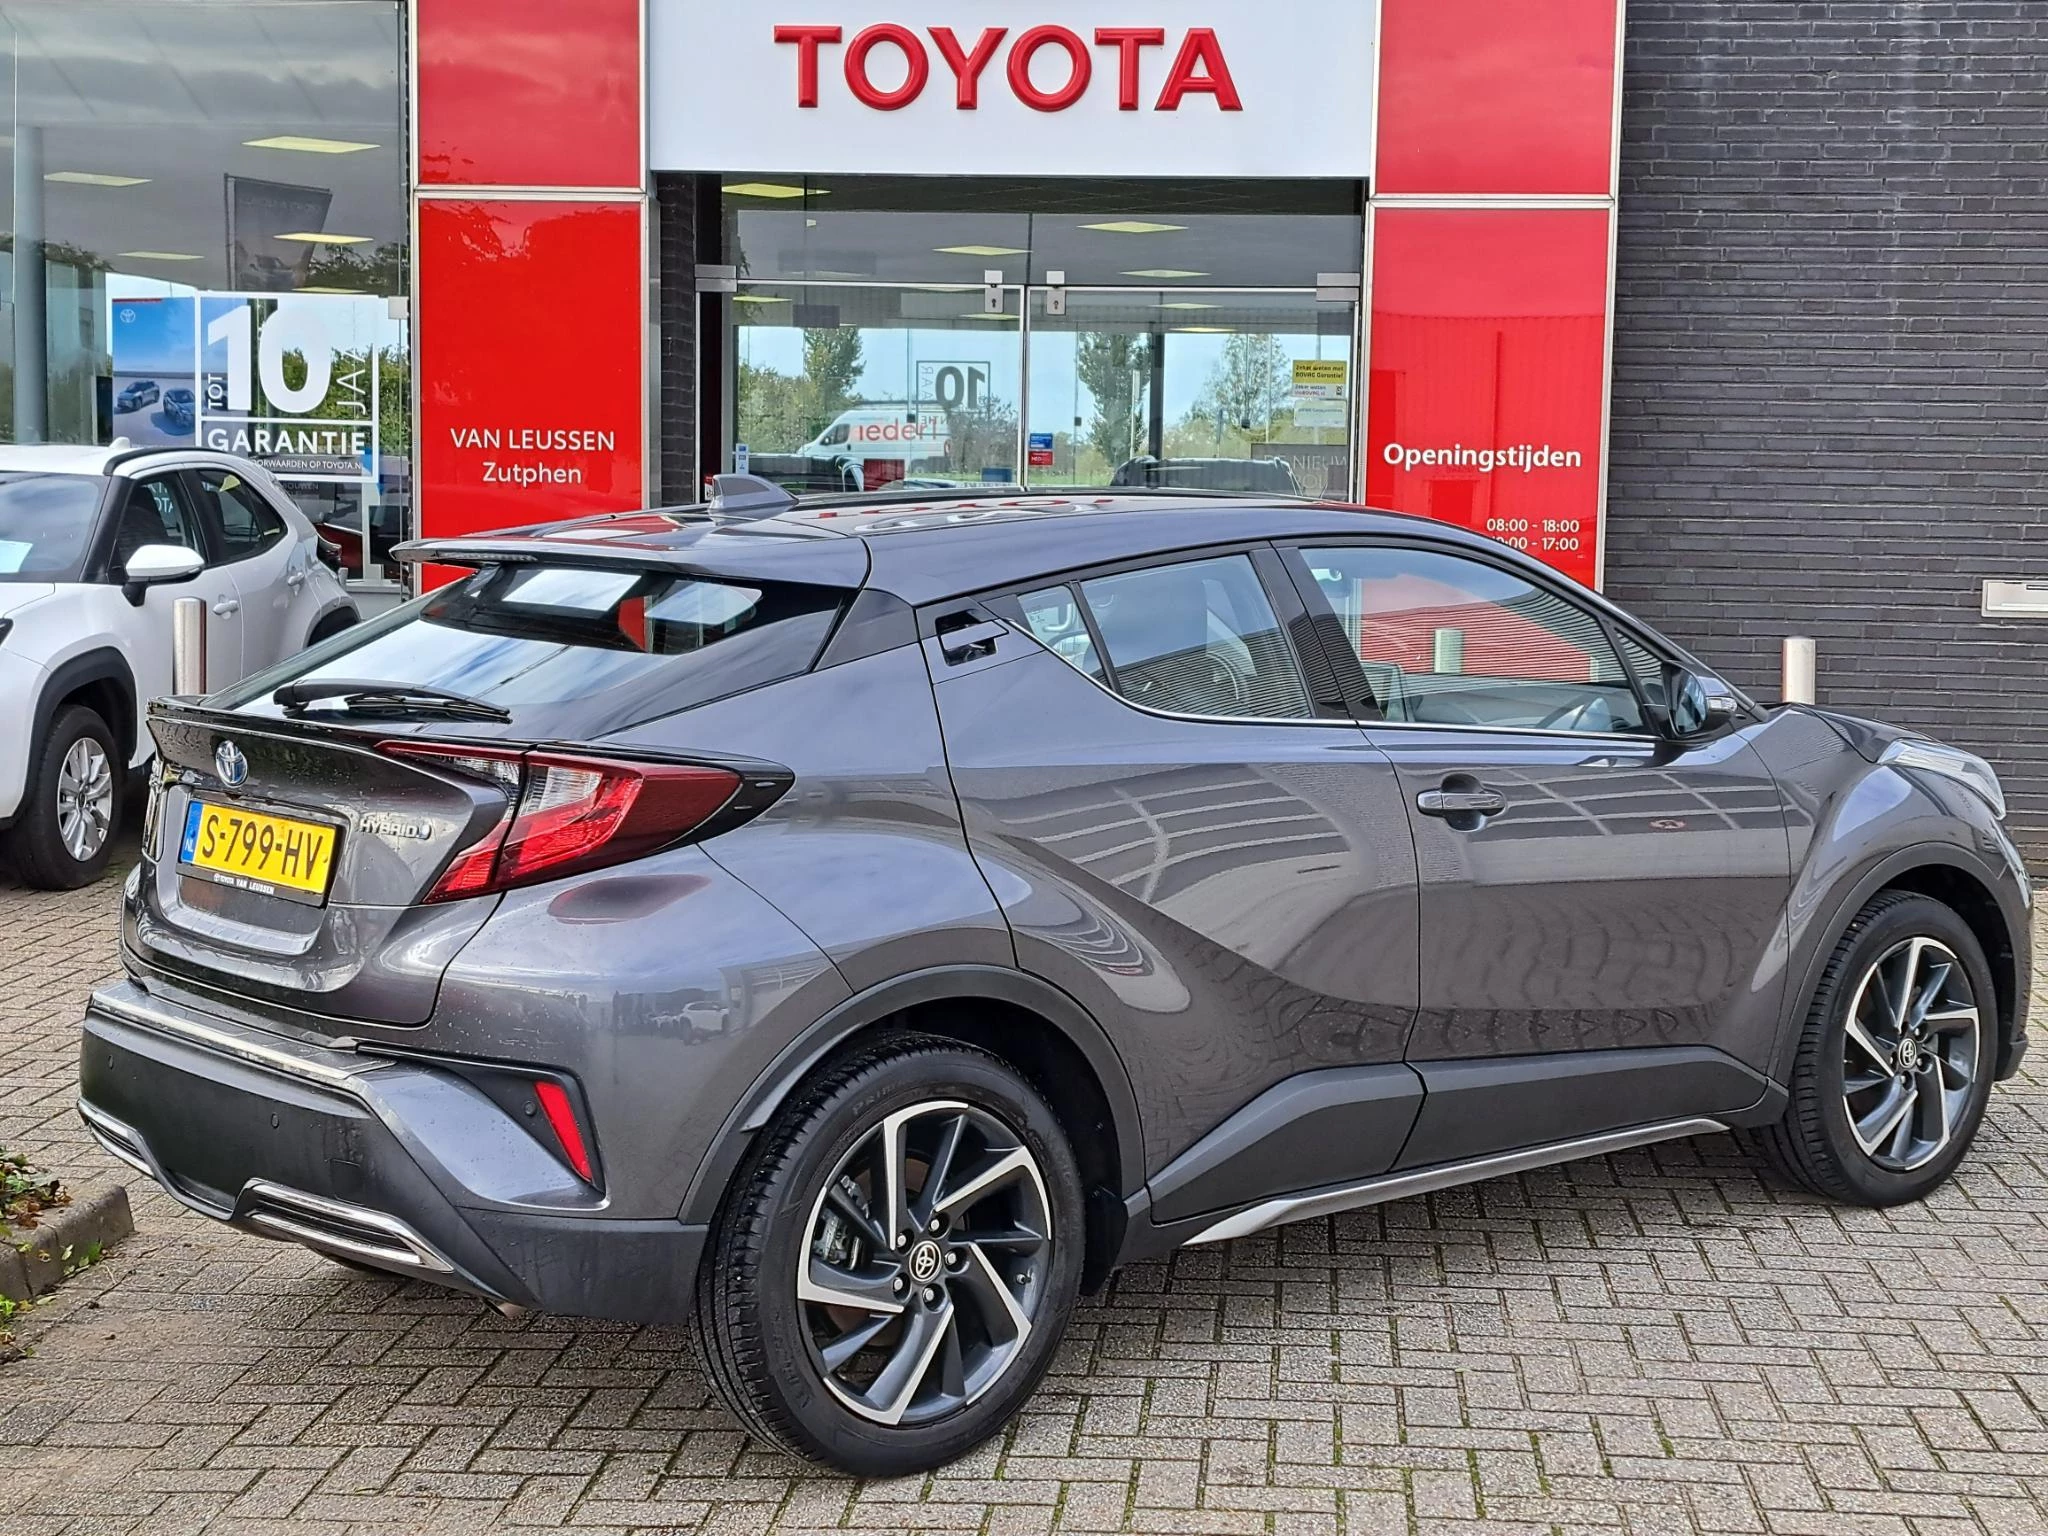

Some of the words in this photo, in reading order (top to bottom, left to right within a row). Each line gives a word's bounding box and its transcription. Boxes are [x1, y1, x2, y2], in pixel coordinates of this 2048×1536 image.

[773, 23, 1243, 112] TOYOTA
[207, 303, 332, 414] 10
[208, 374, 223, 410] TOT
[207, 428, 366, 456] GARANTIE
[450, 428, 500, 449] VAN
[508, 429, 614, 451] LEUSSEN
[251, 459, 307, 468] OORWAARDEN
[309, 460, 322, 469] OP
[322, 461, 361, 470] TOYOTA.N
[1383, 443, 1582, 473] Openingstijden
[482, 462, 582, 488] Zutphen
[1486, 518, 1528, 532] 08:00
[1542, 519, 1580, 533] 18:00
[1491, 536, 1528, 550] :00
[1541, 537, 1579, 551] 17:00
[359, 818, 420, 838] HYBRID
[184, 838, 194, 853] NL
[202, 814, 323, 880] S-799-HV
[236, 878, 248, 889] VAN
[249, 881, 275, 895] LEUSSEN
